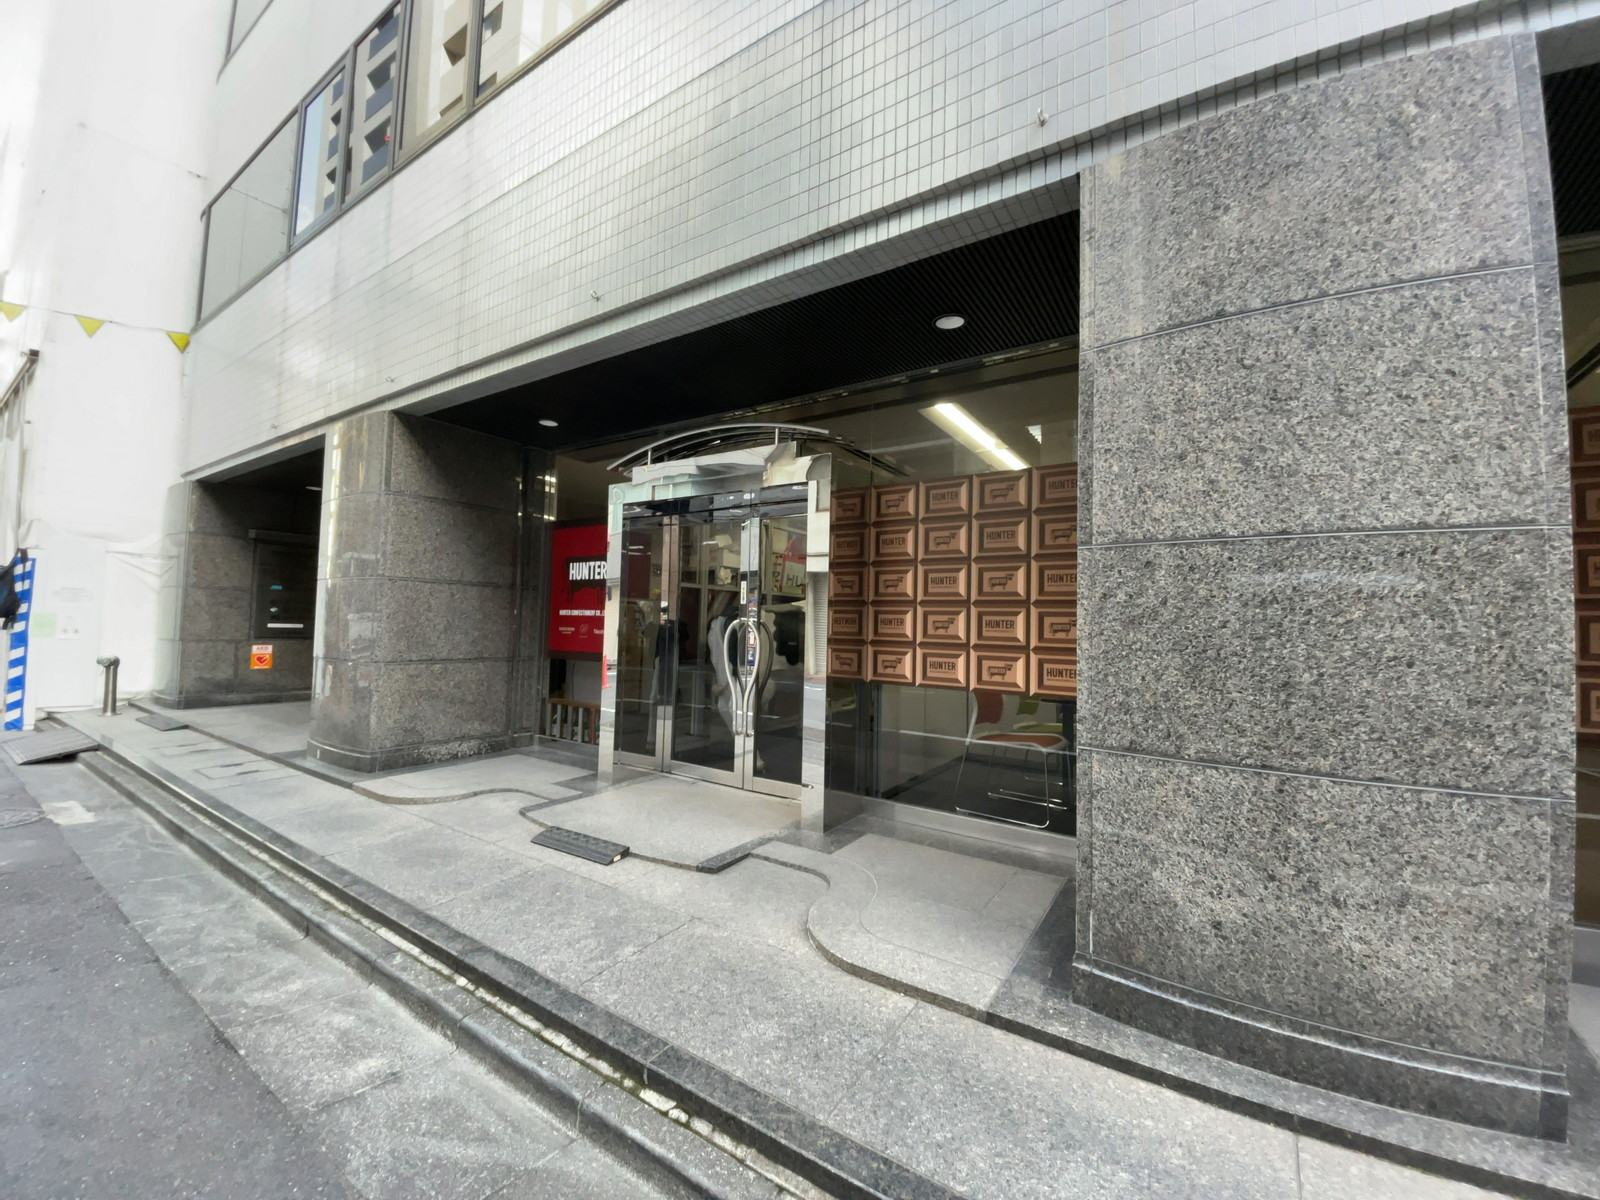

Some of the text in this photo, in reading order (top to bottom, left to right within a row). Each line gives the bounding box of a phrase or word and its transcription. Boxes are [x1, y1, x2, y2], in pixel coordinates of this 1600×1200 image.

[931, 491, 959, 501] HUNTER
[986, 530, 1016, 540] HUNTER
[881, 537, 906, 546] HUNTER
[569, 561, 607, 580] HUNTER
[930, 576, 958, 585] HUNTER
[880, 617, 904, 626] HUNTER
[985, 619, 1015, 630] HUNTER
[929, 660, 956, 671] HUNTER
